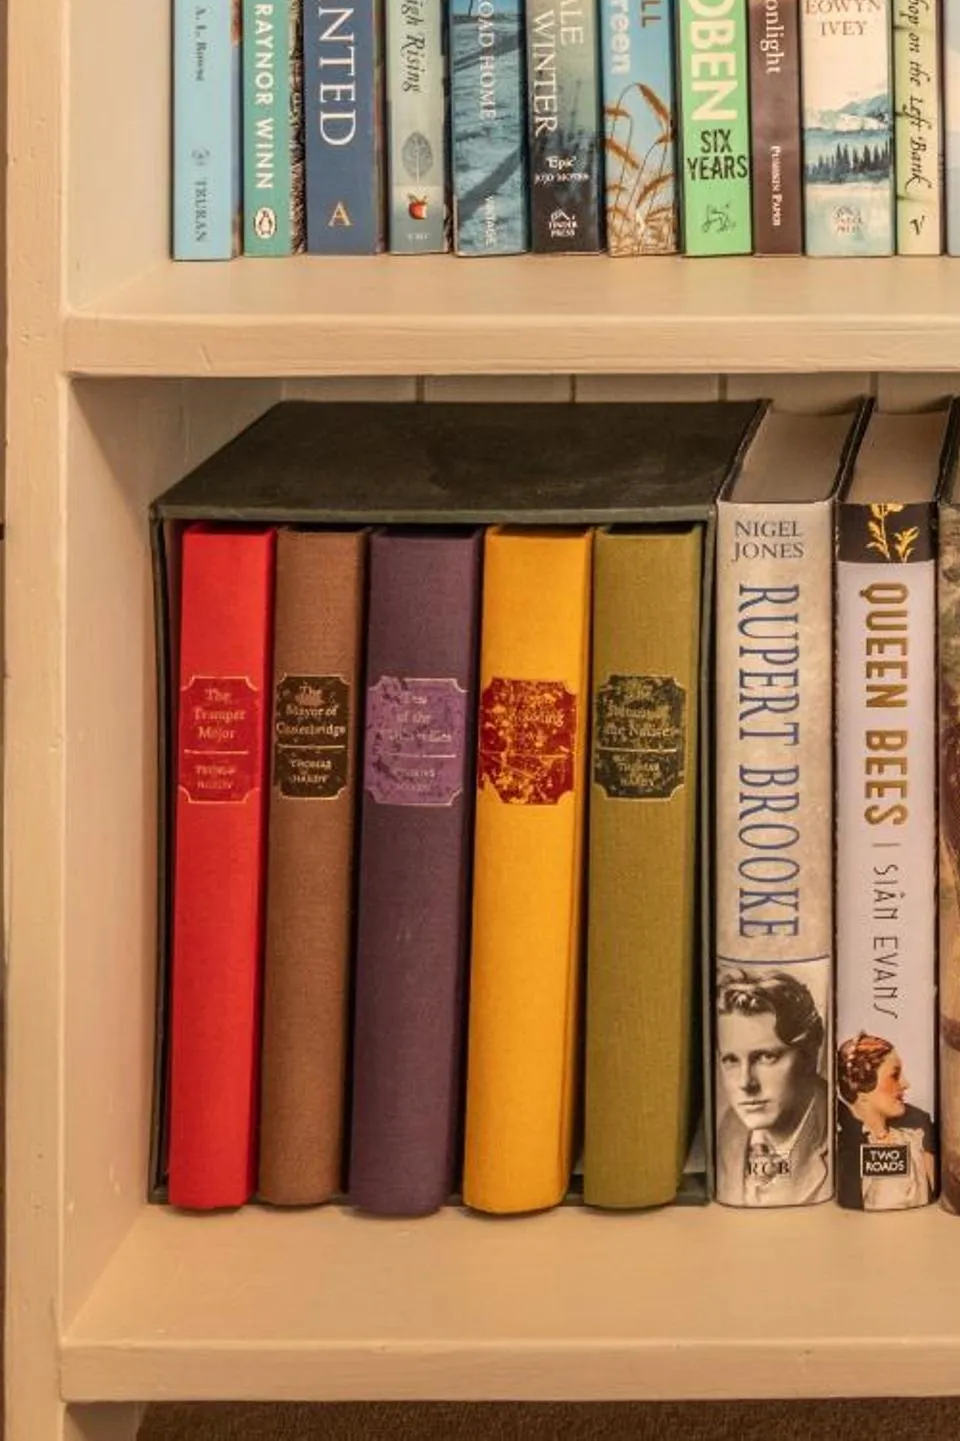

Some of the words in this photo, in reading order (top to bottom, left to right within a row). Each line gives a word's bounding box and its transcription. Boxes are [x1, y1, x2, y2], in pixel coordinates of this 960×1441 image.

[820, 20, 868, 36] IVEY
[907, 32, 921, 53] on
[254, 3, 274, 105] RAYNOR
[401, 32, 426, 93] Rising
[532, 10, 558, 137] WINTER
[907, 61, 925, 86] the
[478, 55, 497, 120] HOME
[903, 95, 932, 131] Left
[255, 118, 274, 189] WINN
[700, 129, 732, 154] SIX
[904, 135, 928, 193] Bank
[687, 156, 748, 181] YEARS
[732, 543, 804, 562] JONES
[735, 520, 804, 538] NIGEL
[735, 583, 802, 749] RUPERT
[859, 581, 908, 710] QUEEN
[863, 728, 908, 826] BEES
[737, 764, 803, 941] BROOKE
[864, 1160, 906, 1173] ROADS
[869, 1149, 900, 1161] TWO
